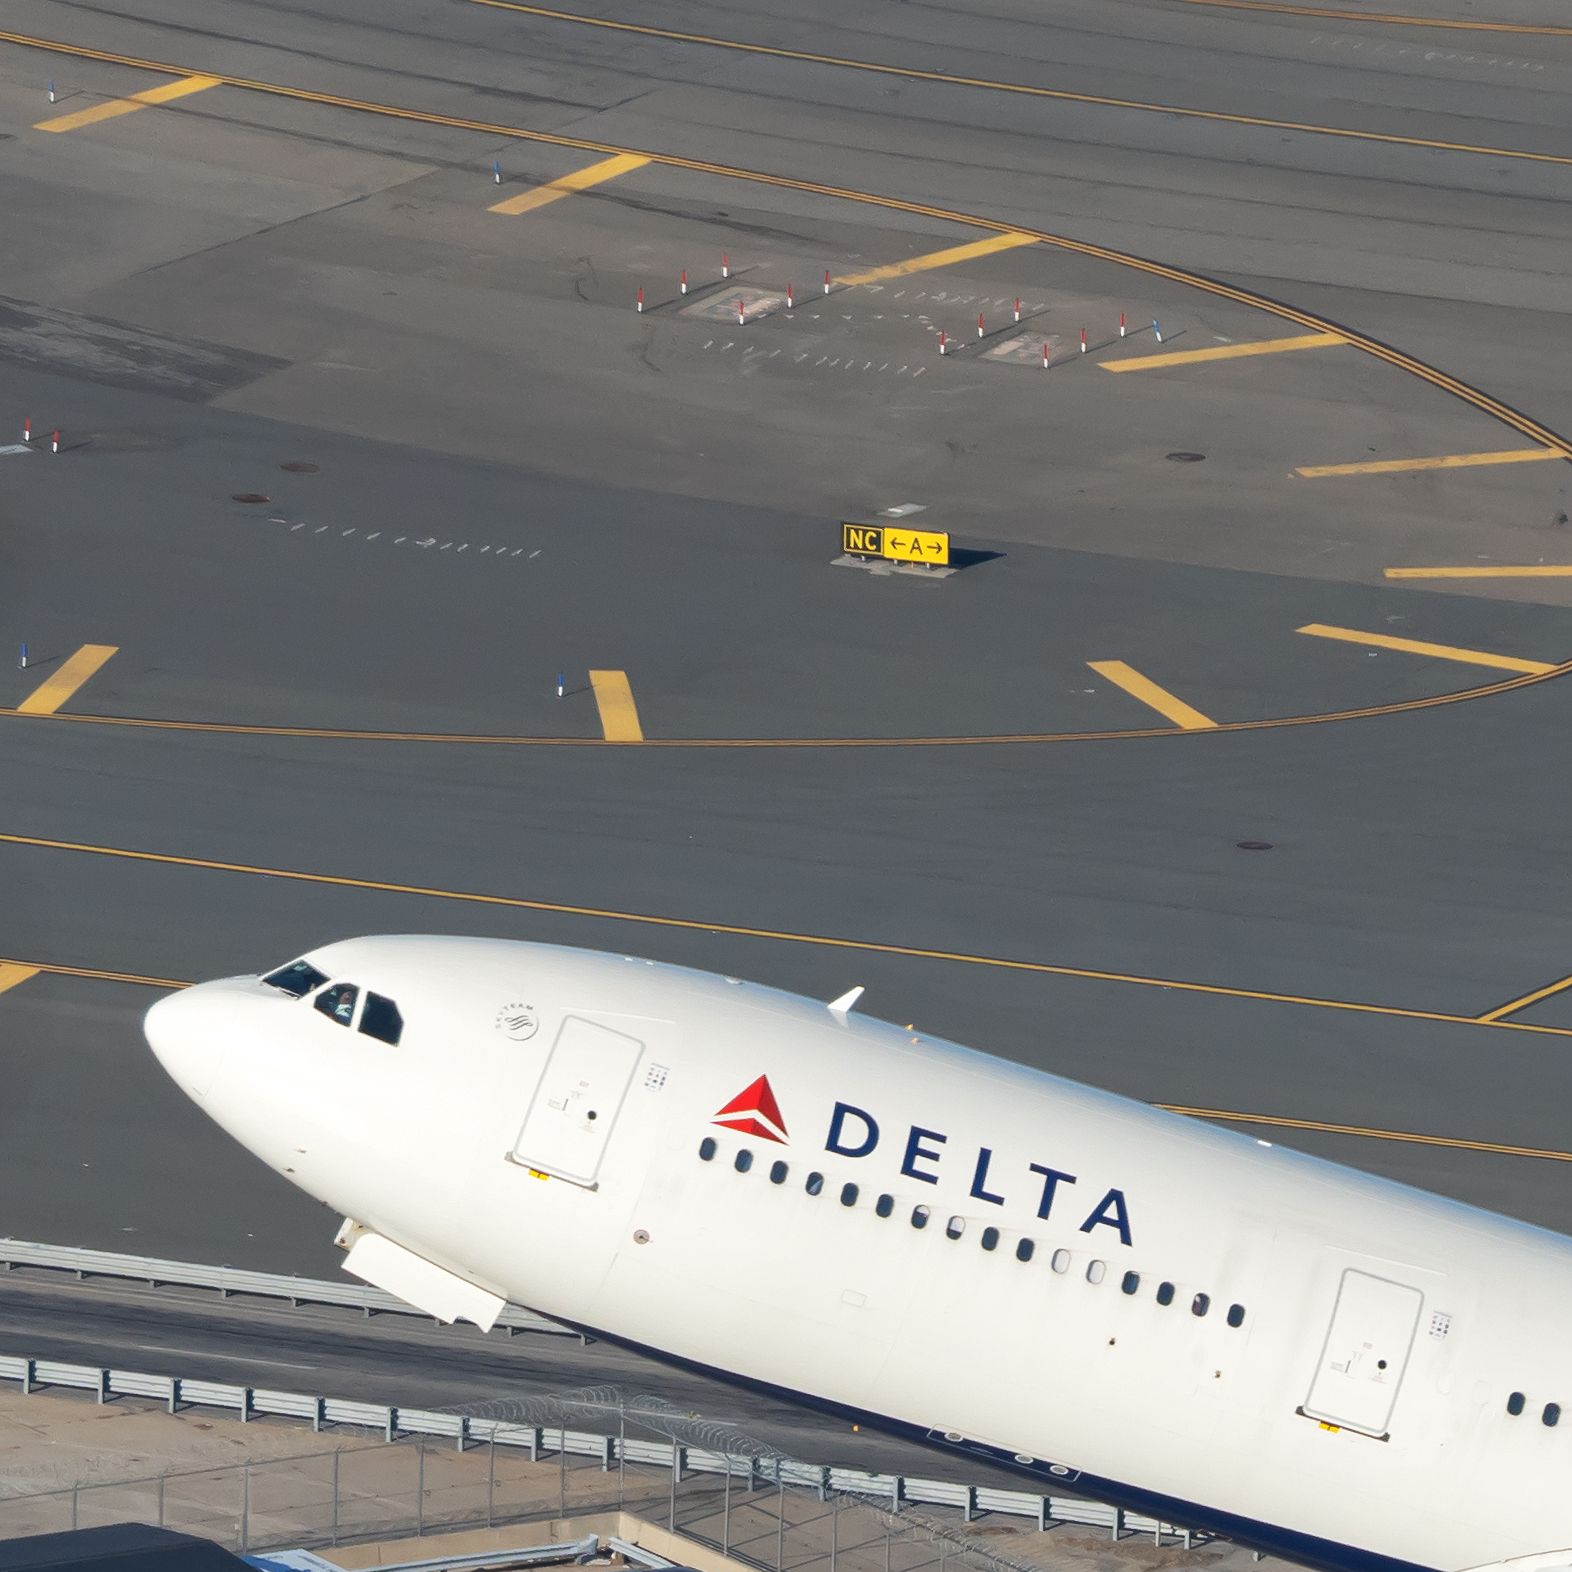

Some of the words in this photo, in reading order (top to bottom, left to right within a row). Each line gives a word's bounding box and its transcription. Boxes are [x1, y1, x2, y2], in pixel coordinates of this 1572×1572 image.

[849, 528, 877, 551] NC
[910, 537, 923, 555] A
[824, 1101, 1135, 1247] DELTA
